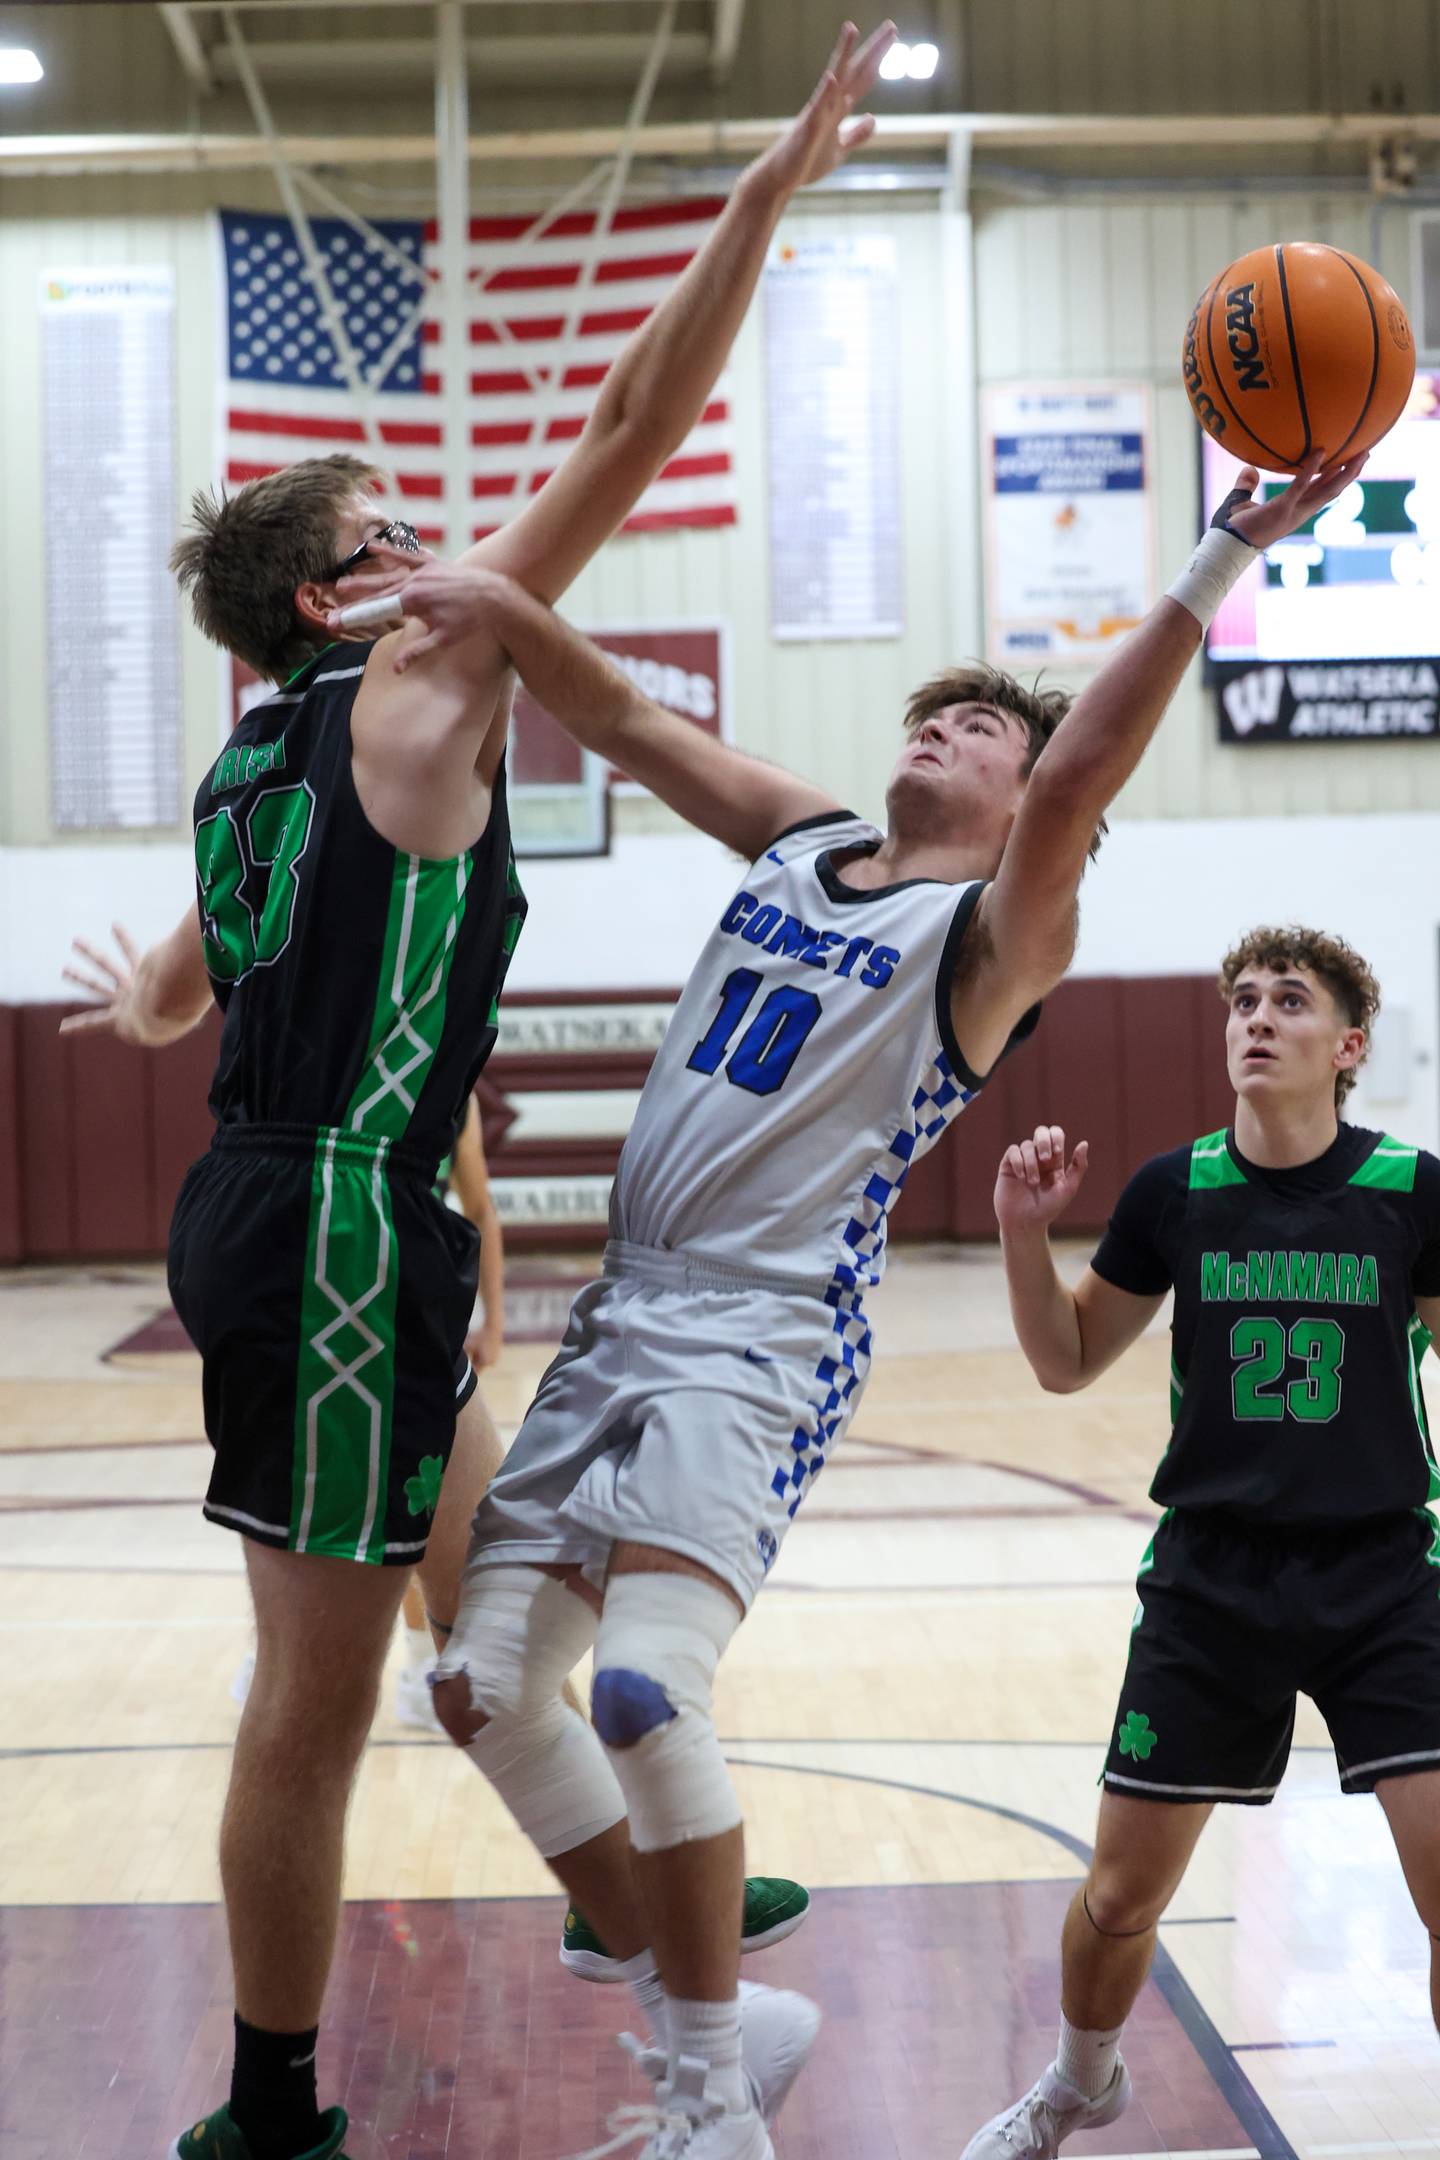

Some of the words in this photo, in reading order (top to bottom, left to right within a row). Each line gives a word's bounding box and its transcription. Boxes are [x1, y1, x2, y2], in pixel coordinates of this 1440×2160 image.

[1225, 281, 1270, 392] NCAA
[1222, 666, 1285, 735] W
[720, 891, 901, 990] COMETS
[685, 967, 823, 1096] 10
[1201, 1250, 1380, 1306] McNAMARA
[1230, 1316, 1345, 1423] 23
